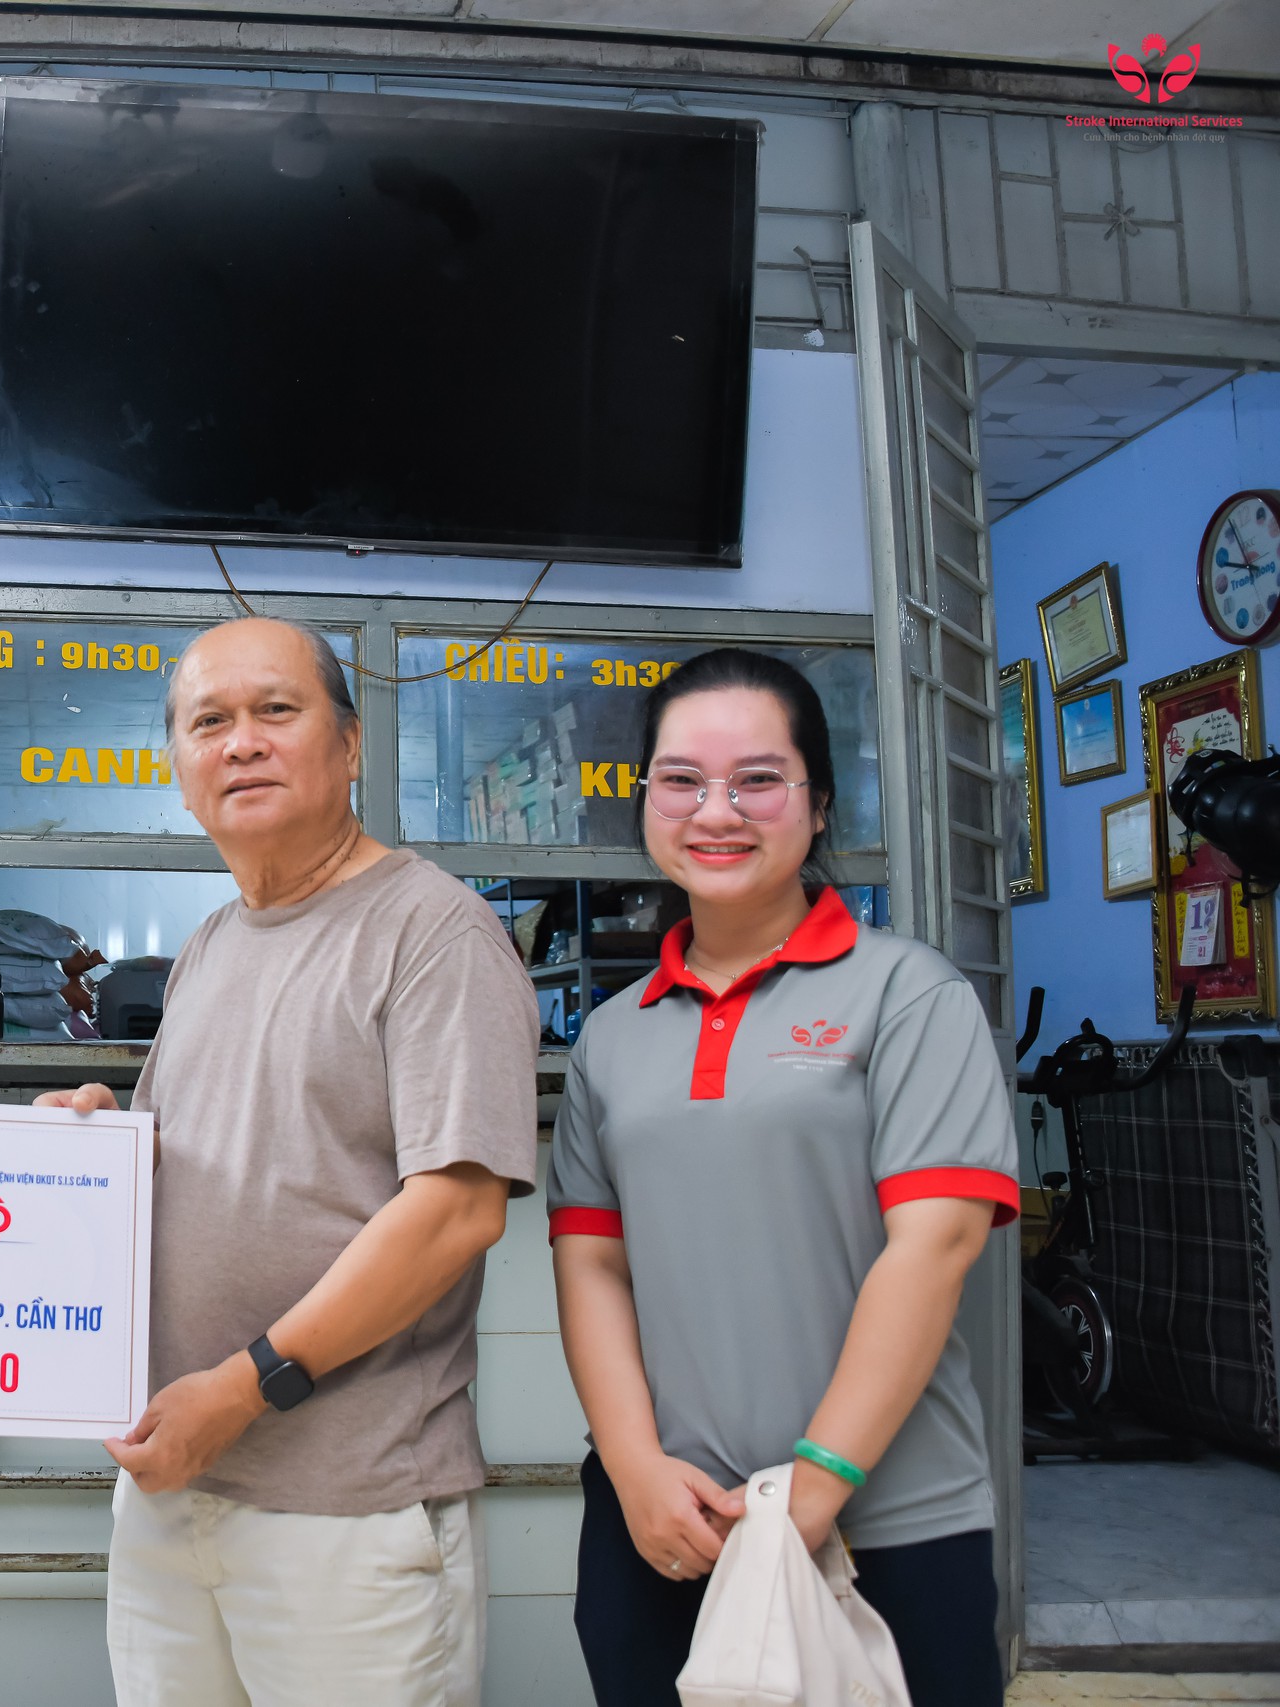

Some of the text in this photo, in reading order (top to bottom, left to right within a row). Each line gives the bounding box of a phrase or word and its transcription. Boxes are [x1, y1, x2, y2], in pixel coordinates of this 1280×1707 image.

[21, 747, 171, 784] CANH
[17, 1172, 33, 1185] VIỆN
[58, 1176, 74, 1186] S.I.S
[16, 1298, 56, 1329] CẦN
[64, 1306, 102, 1332] THƠ
